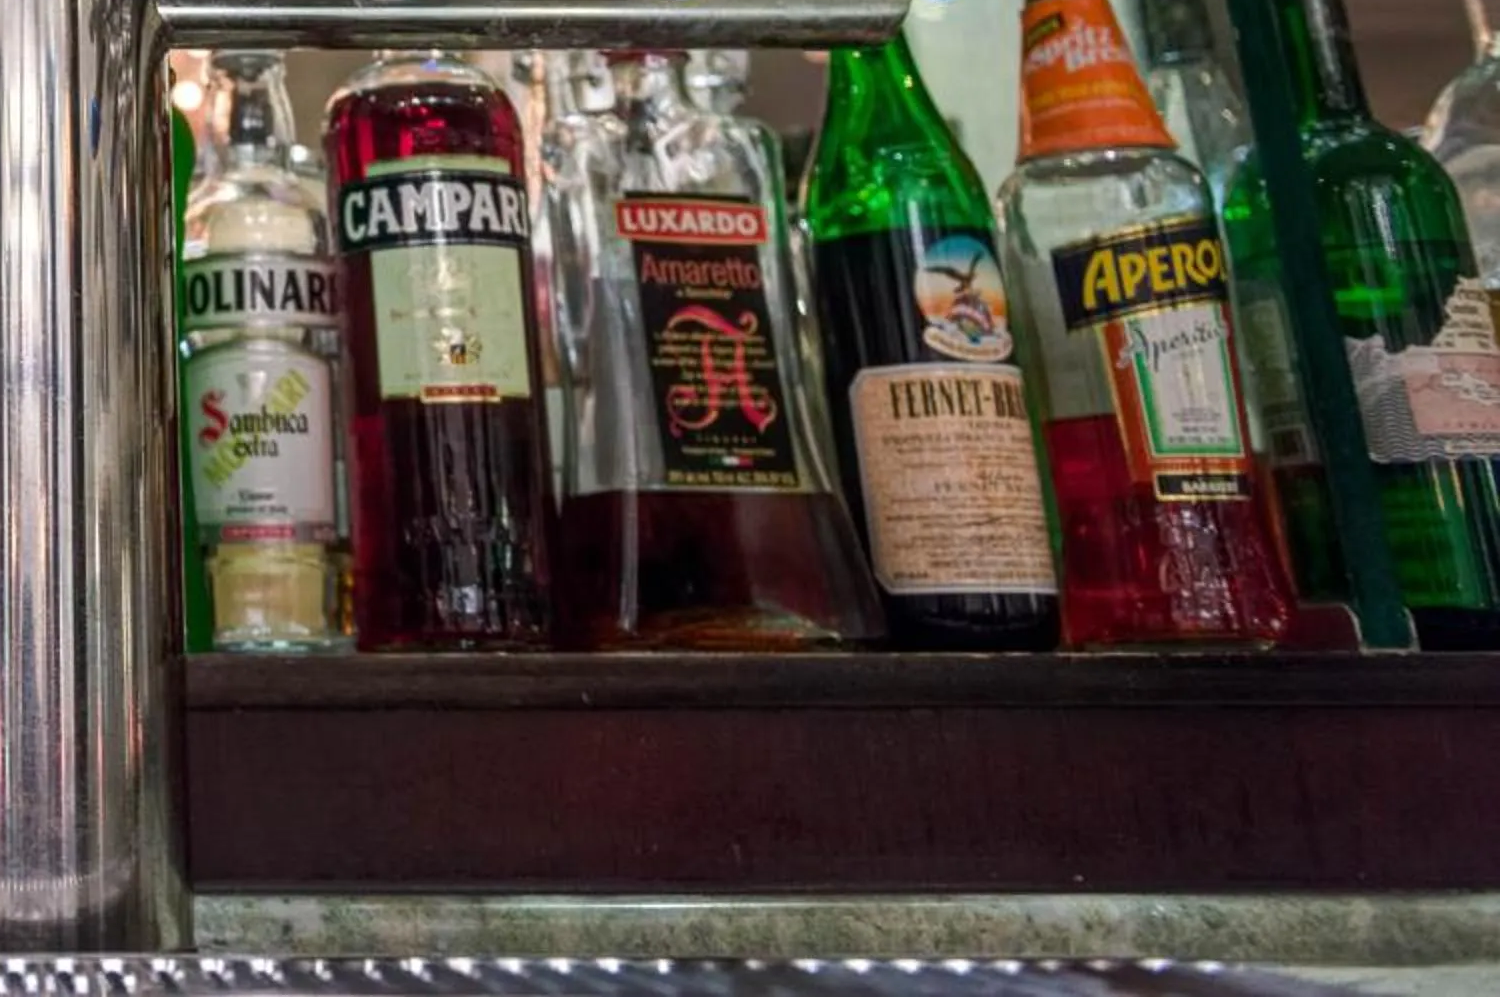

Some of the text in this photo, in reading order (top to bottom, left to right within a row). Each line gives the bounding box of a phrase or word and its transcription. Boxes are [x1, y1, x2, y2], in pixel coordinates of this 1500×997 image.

[344, 181, 530, 244] CAMPARI
[621, 206, 759, 237] LUXARDO
[641, 253, 763, 290] Amaretto
[199, 389, 309, 449] Sambuca
